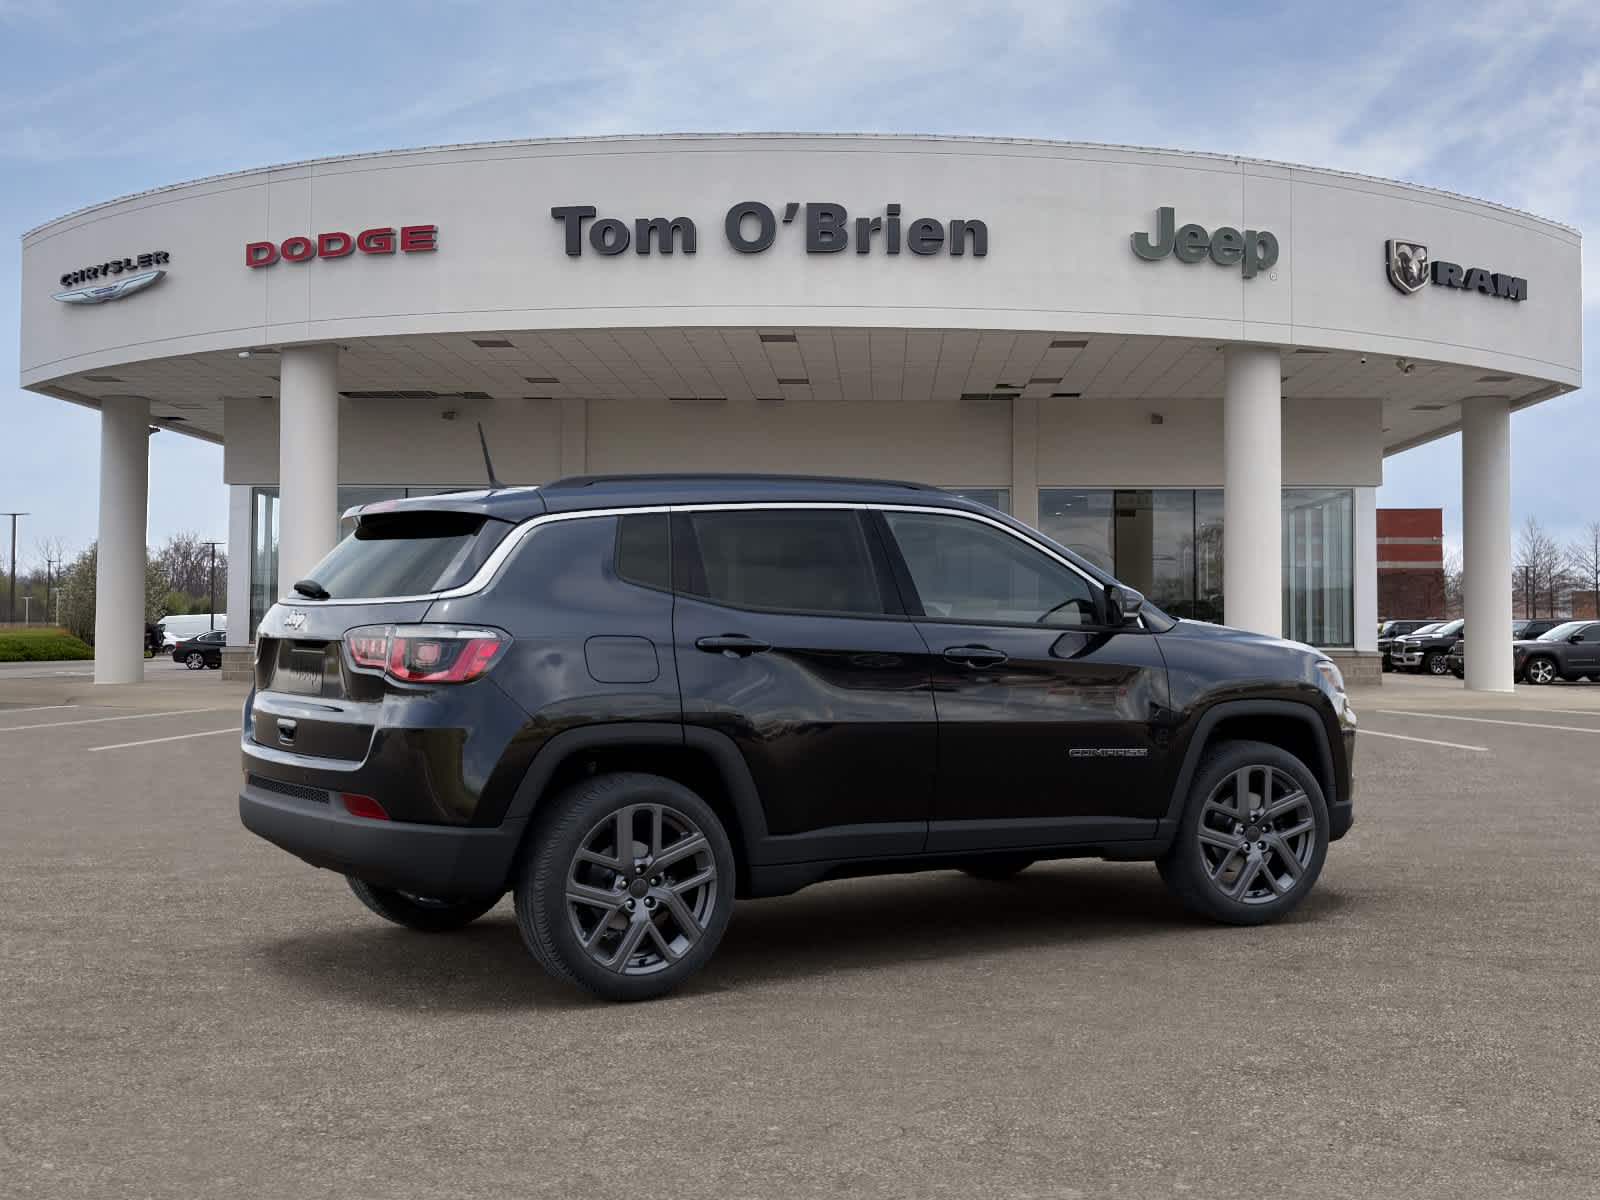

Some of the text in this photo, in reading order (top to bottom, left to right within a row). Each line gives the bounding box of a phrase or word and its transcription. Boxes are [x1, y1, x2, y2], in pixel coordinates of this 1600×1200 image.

[246, 225, 437, 268] DODGE
[551, 201, 989, 256] Tom O'Brien
[1130, 206, 1279, 279] Jeep
[60, 251, 170, 287] CHRYSLER
[1431, 260, 1527, 301] RAM
